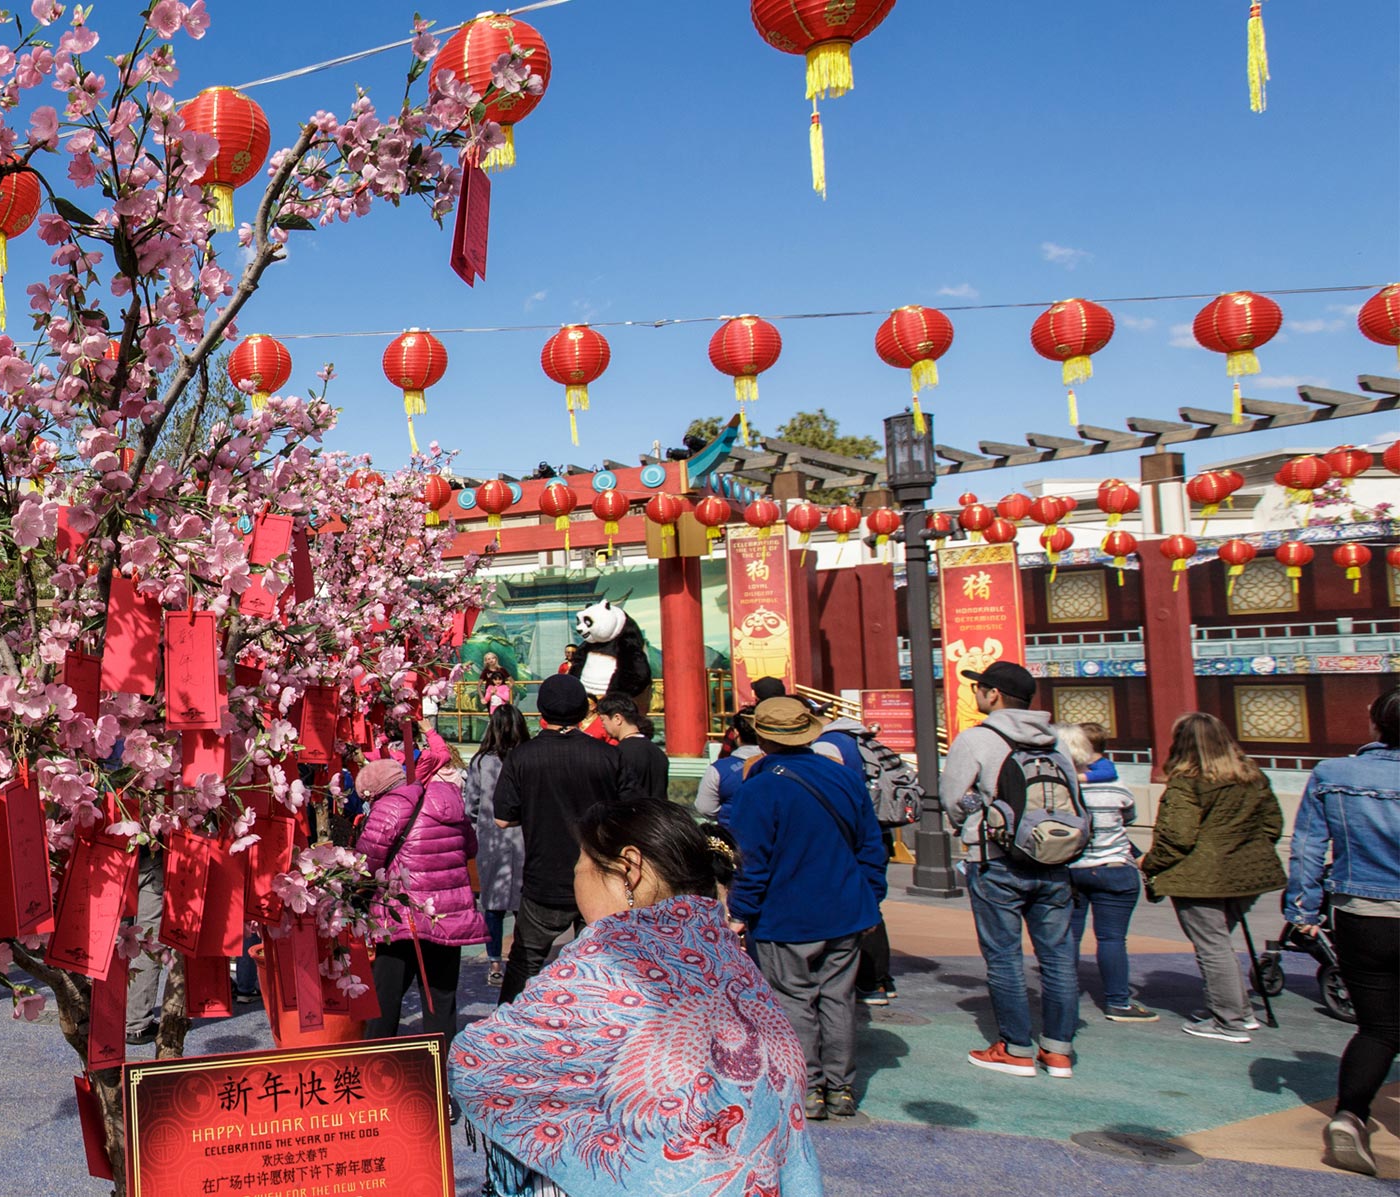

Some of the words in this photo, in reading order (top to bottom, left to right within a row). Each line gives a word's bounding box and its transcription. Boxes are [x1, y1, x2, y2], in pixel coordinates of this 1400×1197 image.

[746, 560, 769, 581] 狗
[962, 571, 993, 600] 猪
[217, 1066, 366, 1116] 新年快樂
[192, 1123, 245, 1143] HAPPY
[250, 1117, 305, 1136] LUNAR
[310, 1113, 343, 1129] NEW
[349, 1108, 391, 1124] YEAR
[204, 1140, 272, 1157] CELEBRATING
[275, 1138, 292, 1148] THE
[295, 1134, 322, 1145] YEAR
[323, 1133, 336, 1143] OF
[339, 1130, 356, 1141] THE
[358, 1128, 379, 1138] DOG
[286, 1188, 307, 1197] FOR
[311, 1185, 330, 1197] THE
[333, 1181, 356, 1194] NEW
[359, 1178, 388, 1191] YEAR
